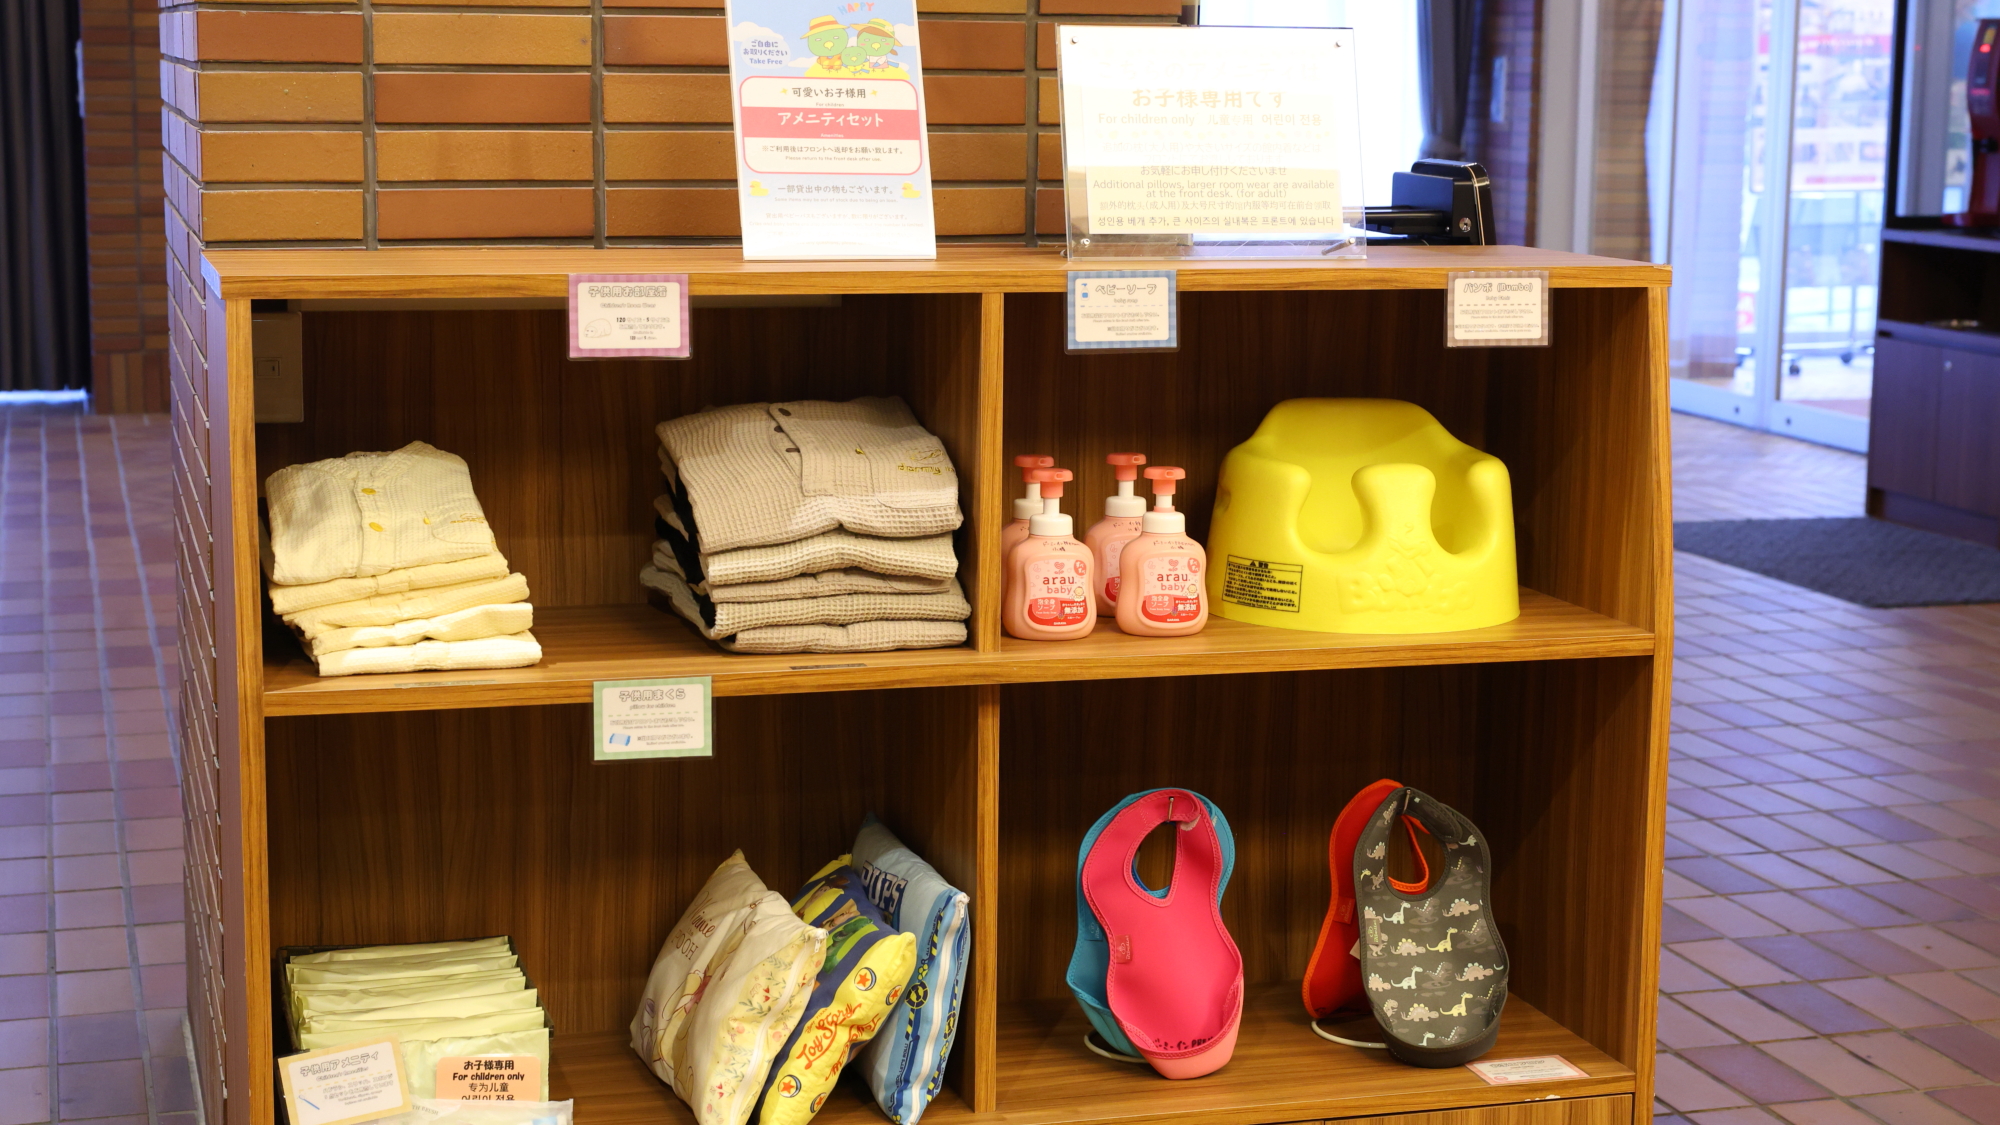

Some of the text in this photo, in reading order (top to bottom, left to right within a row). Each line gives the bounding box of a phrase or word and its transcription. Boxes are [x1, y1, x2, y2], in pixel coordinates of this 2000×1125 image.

[837, 2, 875, 15] HAPPY
[751, 39, 778, 48] ご自由に
[743, 48, 788, 56] お取りください
[792, 87, 866, 98] 可愛いお子様用
[777, 112, 884, 127] アメニティセット
[1098, 112, 1195, 127] For children only
[1206, 113, 1254, 126] 儿童专用
[1261, 113, 1322, 127] 어린이 전용
[1140, 165, 1287, 176] お気軽にお申し付けくださいませ
[777, 184, 893, 195] 一部貸出中の物もございます。
[1093, 180, 1335, 192] Additional pillows, larger room wear are available
[1146, 189, 1287, 200] at the front desk. (for adult)
[1097, 216, 1335, 227] 성인용 베개 추가, 큰 사이즈의 실내복은 프론트에 있습니다
[588, 285, 668, 298] 子供用お部屋着
[1095, 284, 1157, 296] ベビーソープ
[1463, 282, 1493, 293] バンボ
[1046, 585, 1073, 595] baby
[1160, 582, 1186, 592] baby
[1064, 607, 1084, 615] 無添加
[1177, 603, 1197, 611] 無添加
[619, 688, 686, 702] 子供用まくら
[861, 860, 908, 914] PUPS
[671, 928, 699, 961] POOH
[300, 1051, 379, 1077] 子供用アメニティ
[463, 1060, 515, 1071] お子様専用
[452, 1072, 525, 1082] For children only
[468, 1082, 509, 1092] 专为儿童
